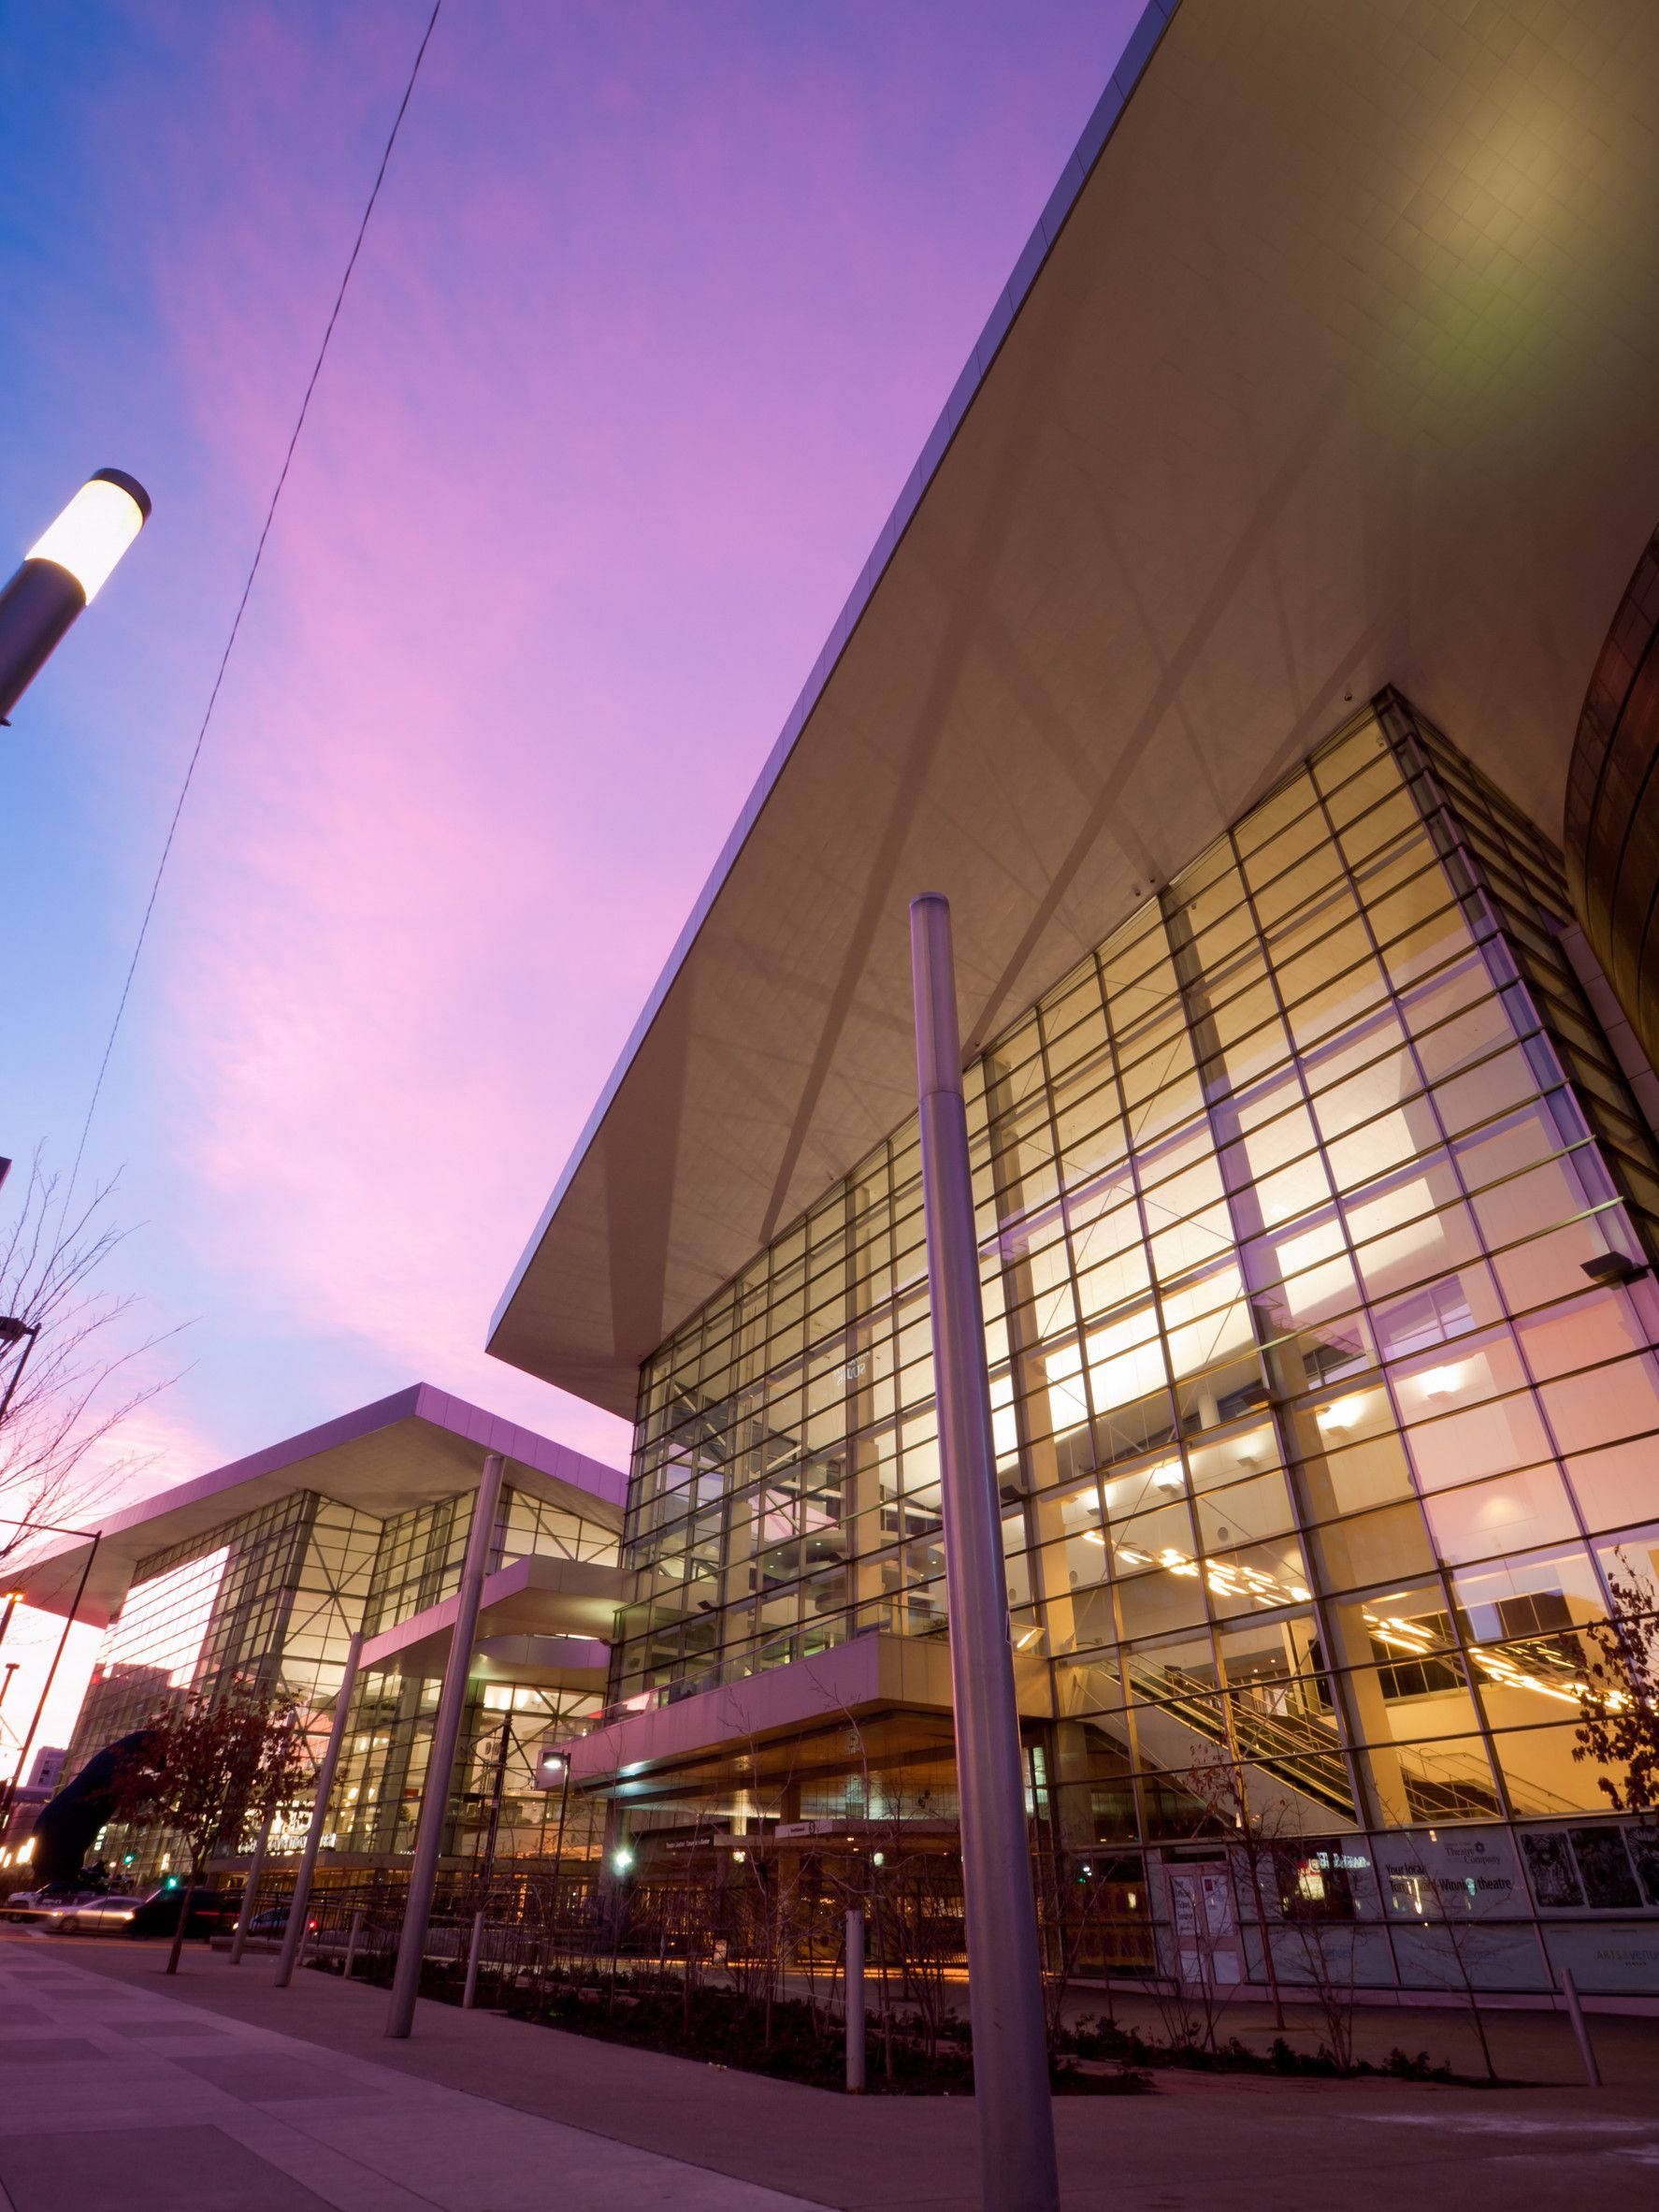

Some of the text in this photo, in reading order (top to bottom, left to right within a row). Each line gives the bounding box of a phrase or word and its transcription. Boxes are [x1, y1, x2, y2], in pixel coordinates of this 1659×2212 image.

[1464, 1856, 1500, 1866] Company
[1385, 1863, 1404, 1875] Your
[1478, 1876, 1512, 1889] theatre
